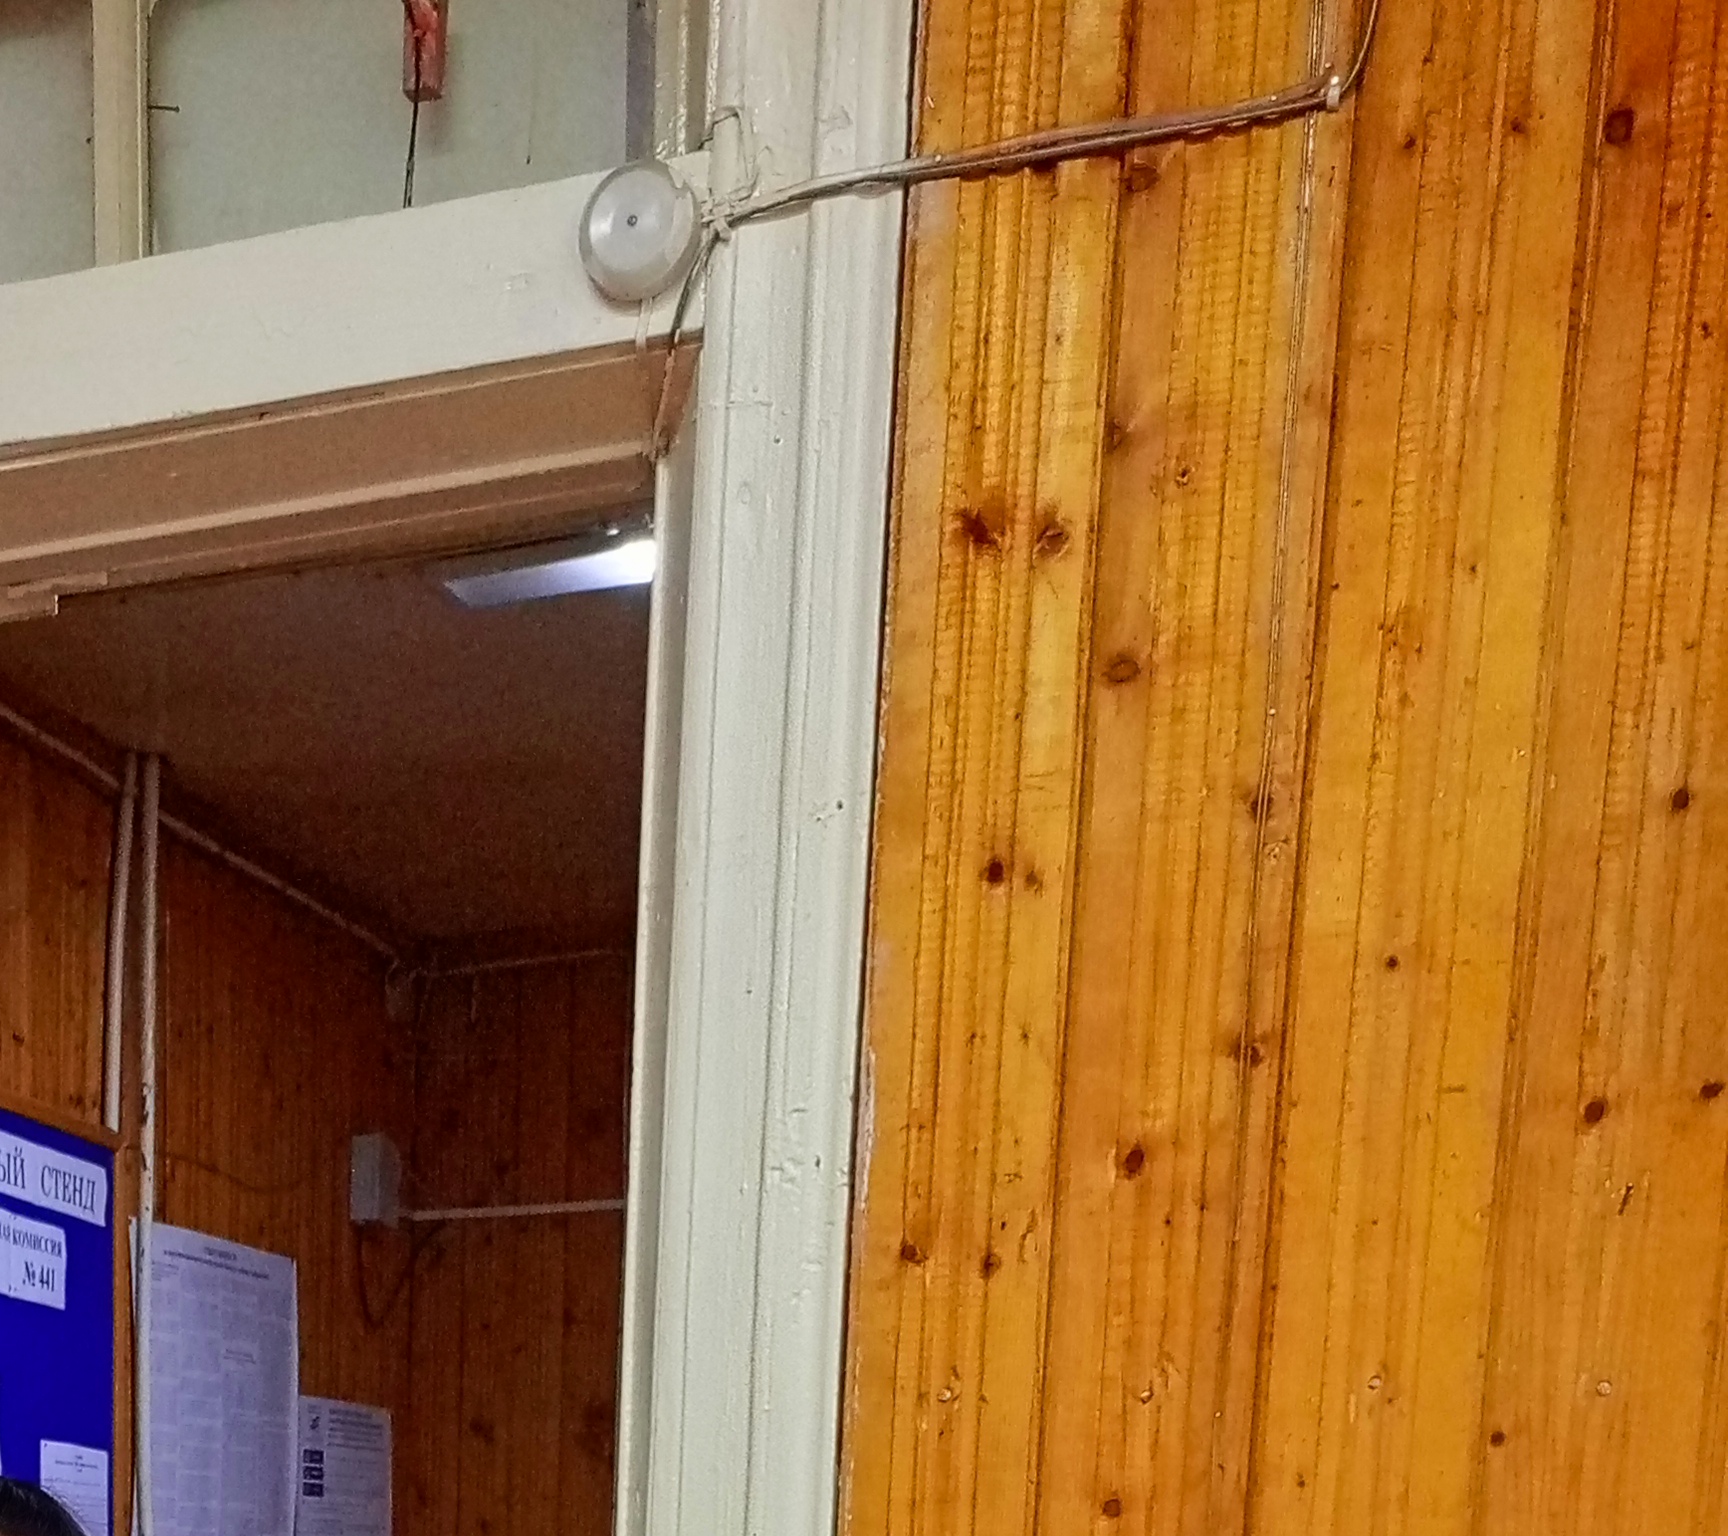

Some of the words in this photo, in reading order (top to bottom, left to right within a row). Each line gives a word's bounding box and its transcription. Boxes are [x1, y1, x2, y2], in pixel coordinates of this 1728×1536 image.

[41, 1164, 97, 1213] СТЕНД
[12, 1228, 63, 1258] КОМИССИЯ
[23, 1260, 36, 1287] №
[39, 1265, 55, 1292] 441
